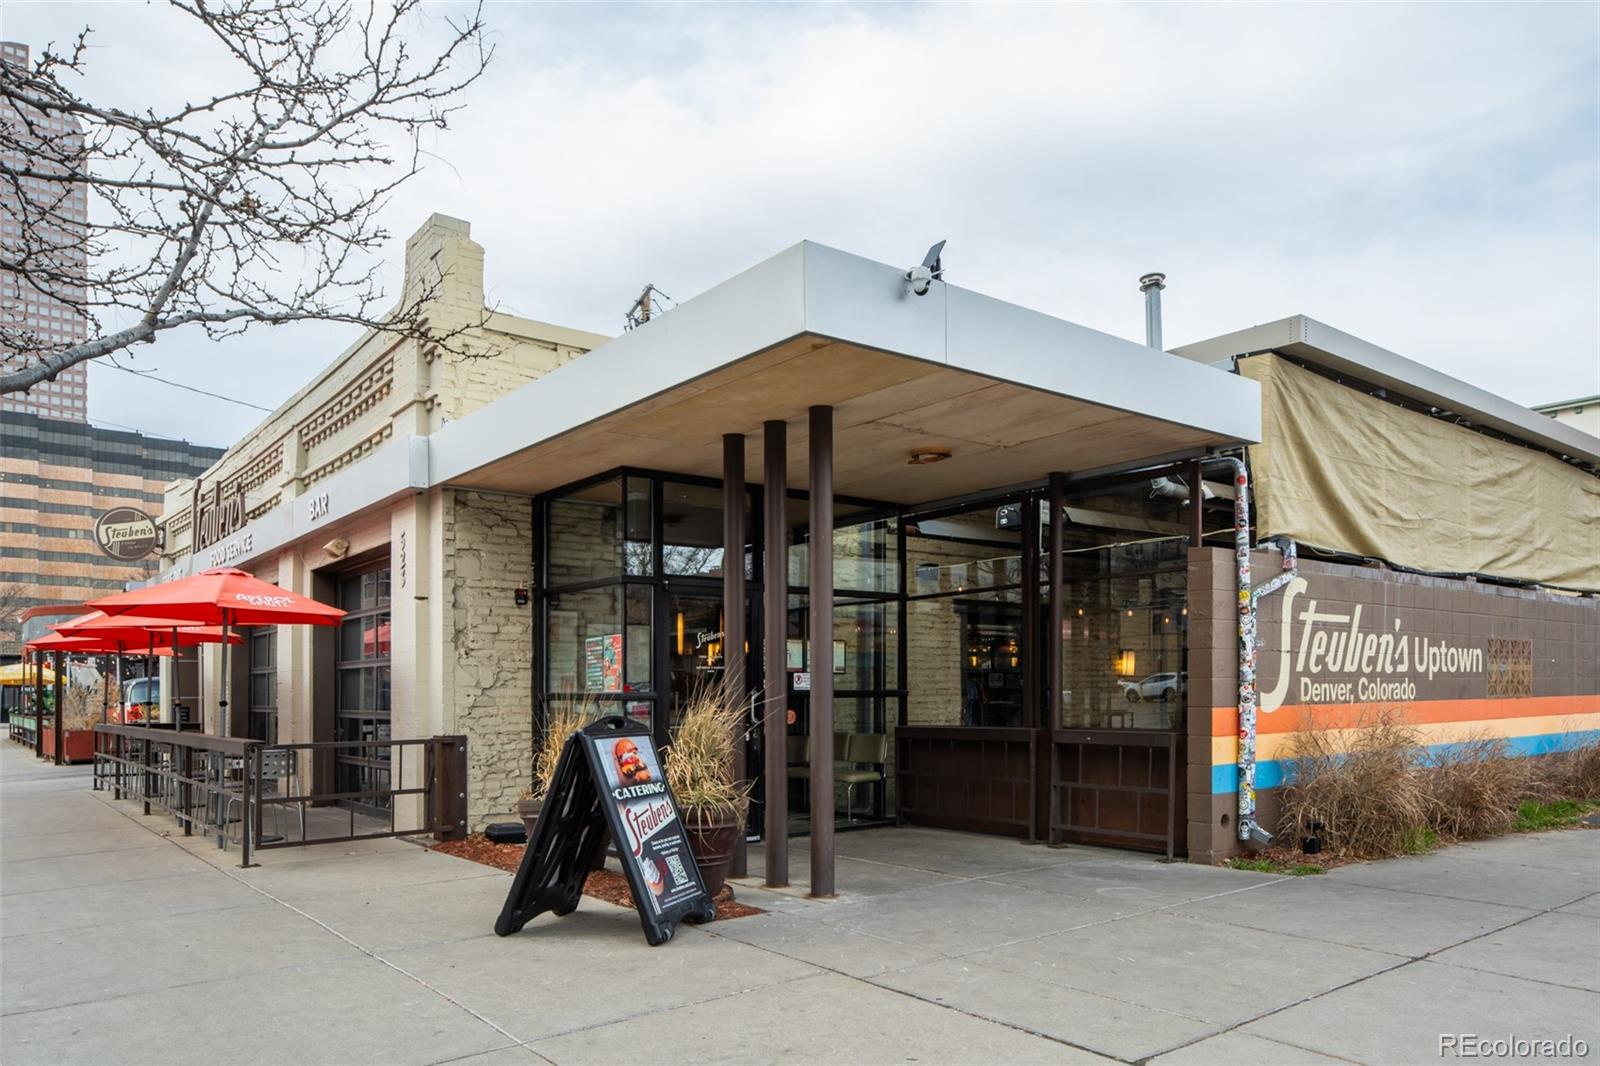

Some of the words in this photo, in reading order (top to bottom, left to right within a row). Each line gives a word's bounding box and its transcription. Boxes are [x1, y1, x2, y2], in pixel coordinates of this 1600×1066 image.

[309, 492, 329, 521] BAR
[101, 525, 153, 548] Steuben's
[209, 547, 227, 568] FOOD
[235, 592, 296, 605] APEROL
[1260, 576, 1409, 714] Steuben's
[1414, 637, 1483, 681] Uptown
[1300, 676, 1355, 705] Denver,
[1358, 677, 1416, 701] Colorado
[613, 782, 666, 801] CATERING
[625, 796, 674, 857] Steuben's
